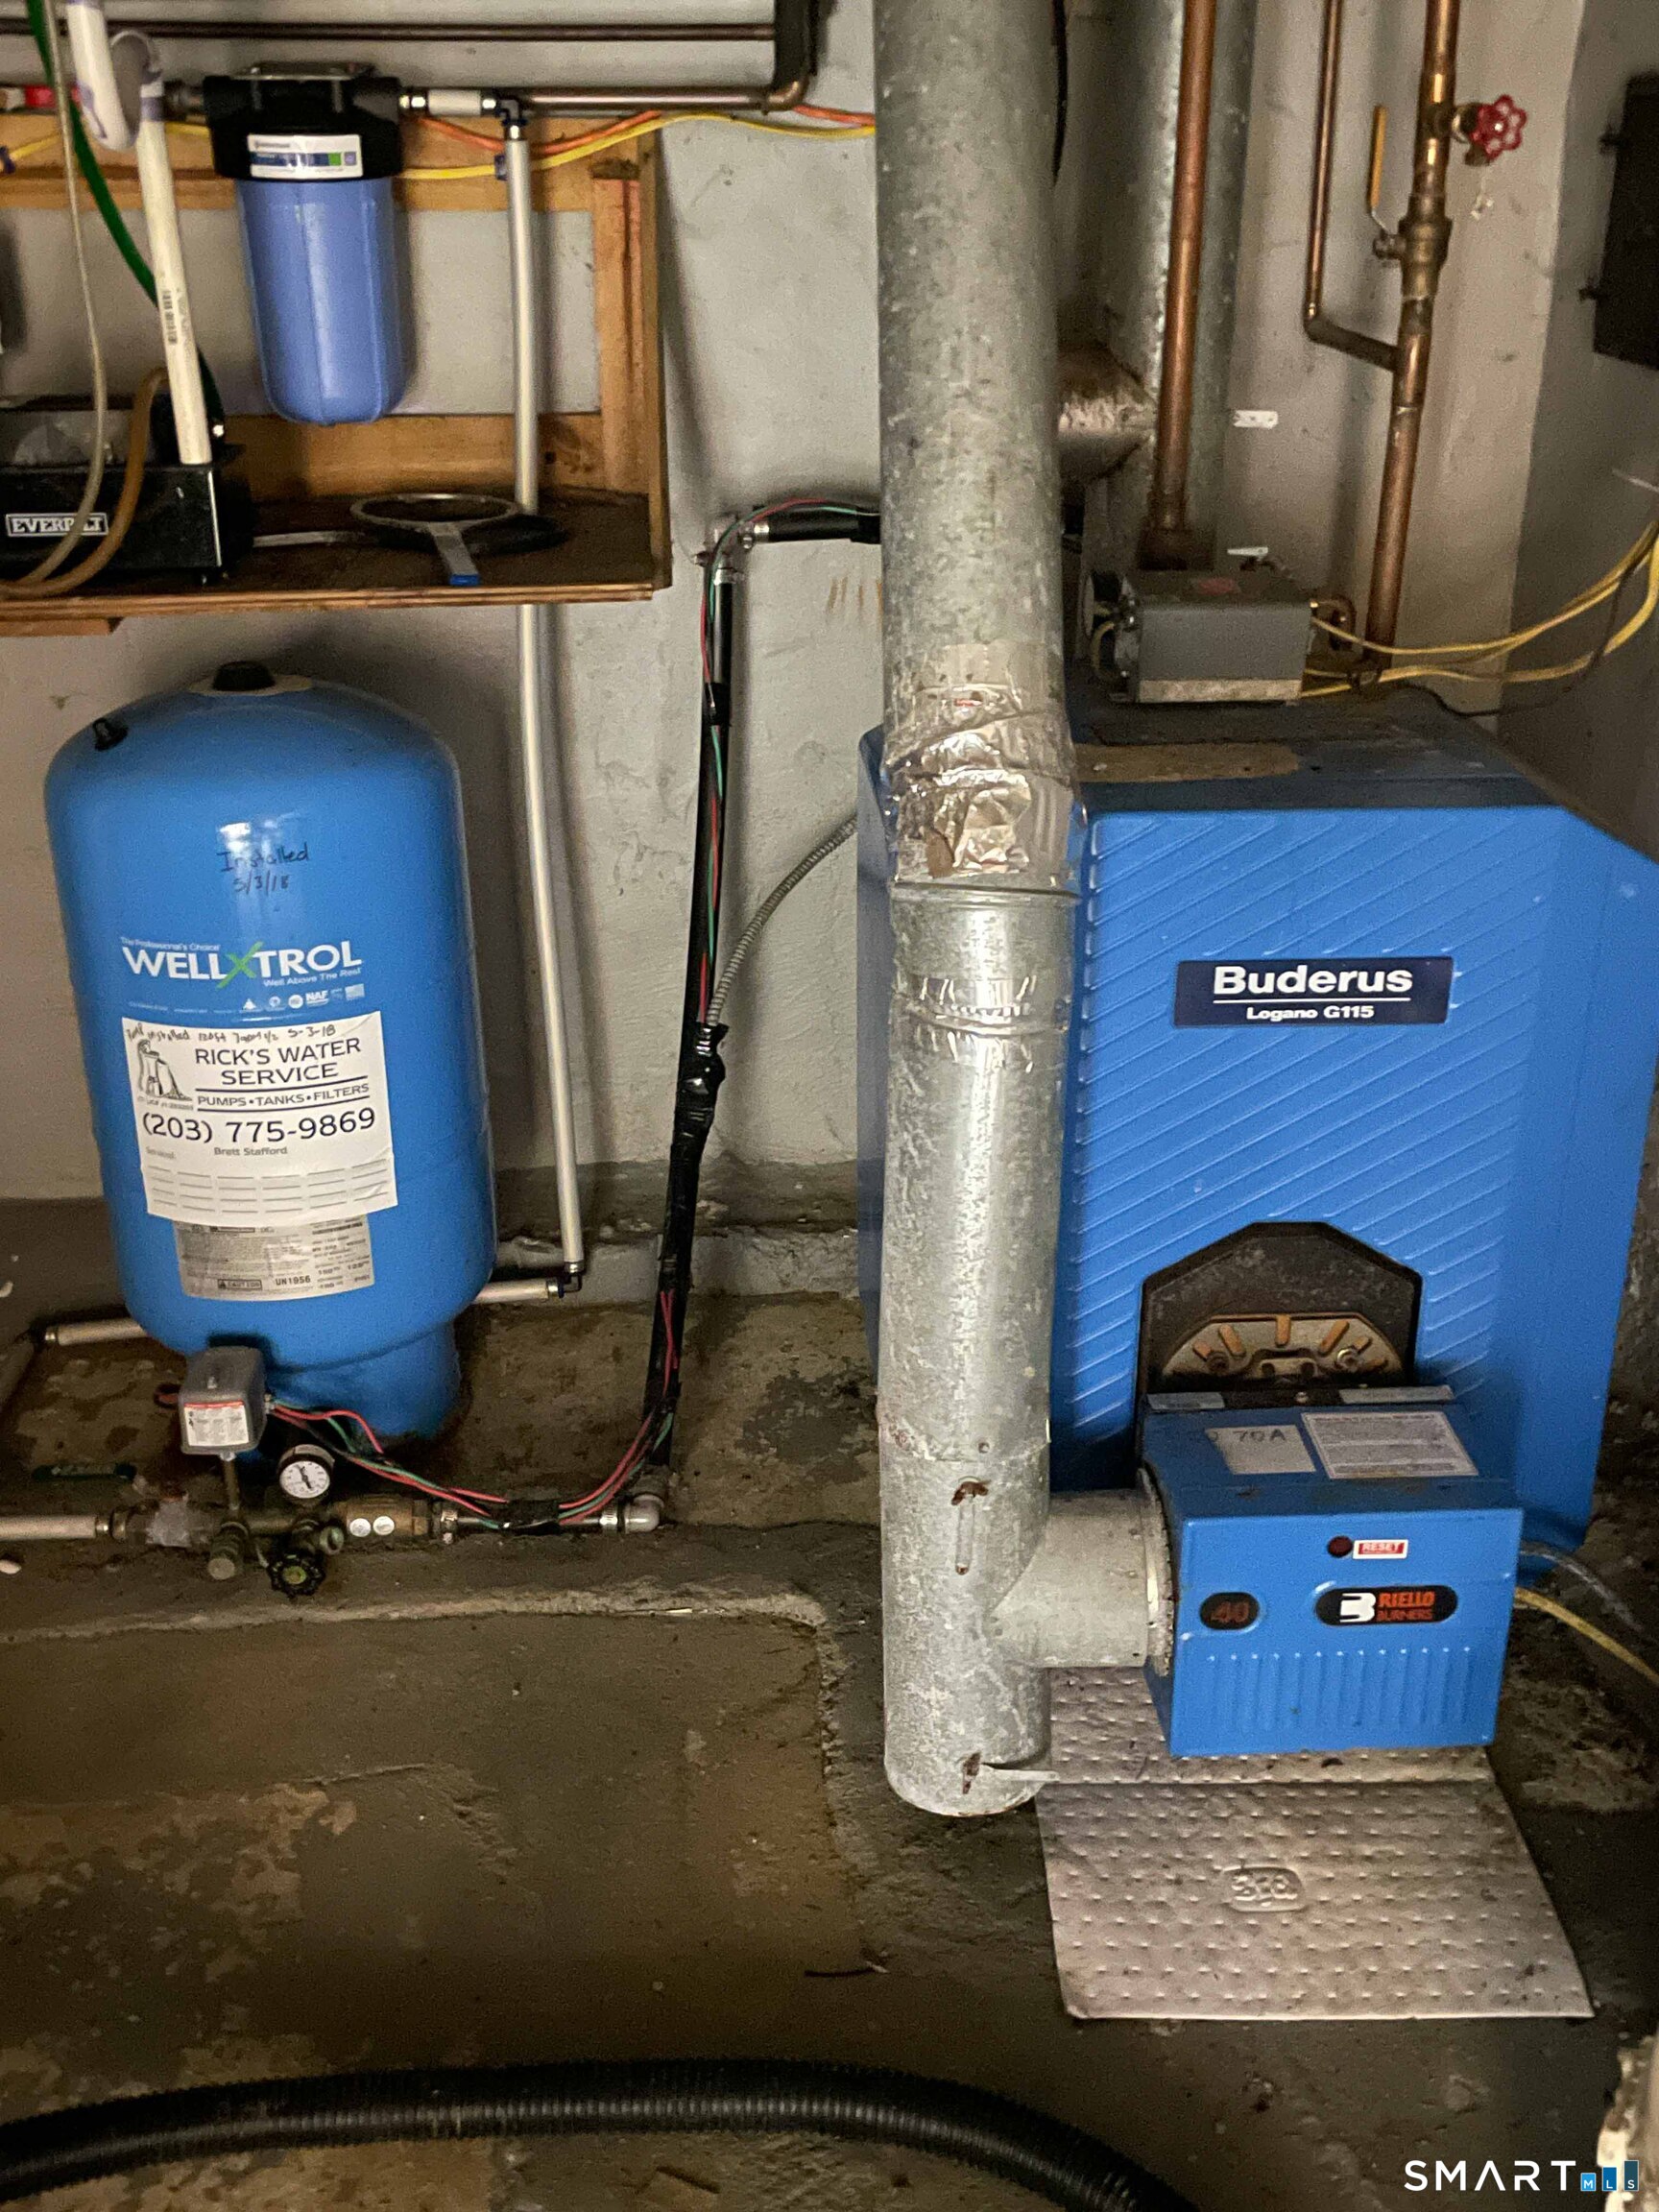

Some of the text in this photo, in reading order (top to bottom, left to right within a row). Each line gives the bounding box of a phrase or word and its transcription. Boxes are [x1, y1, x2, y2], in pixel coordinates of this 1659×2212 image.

[12, 517, 103, 533] EVERBLT
[216, 841, 309, 873] Installed
[287, 975, 318, 985] Above
[1213, 964, 1413, 995] Buderus
[1246, 1005, 1375, 1022] Logano G115
[288, 1023, 336, 1038] 5-3-18
[195, 1037, 362, 1066] RICK'S WATER
[221, 1062, 339, 1086] SERVICE
[198, 1095, 246, 1107] PUMPS
[254, 1094, 305, 1106] TANKS
[314, 1083, 370, 1101] FILTERS
[142, 1106, 375, 1143] (203) 775-9869
[214, 1146, 240, 1156] Brett
[244, 1146, 288, 1157] Stafford
[275, 1274, 311, 1286] UN1956
[1361, 1542, 1400, 1551] RESET
[1379, 1592, 1436, 1608] RIELLO
